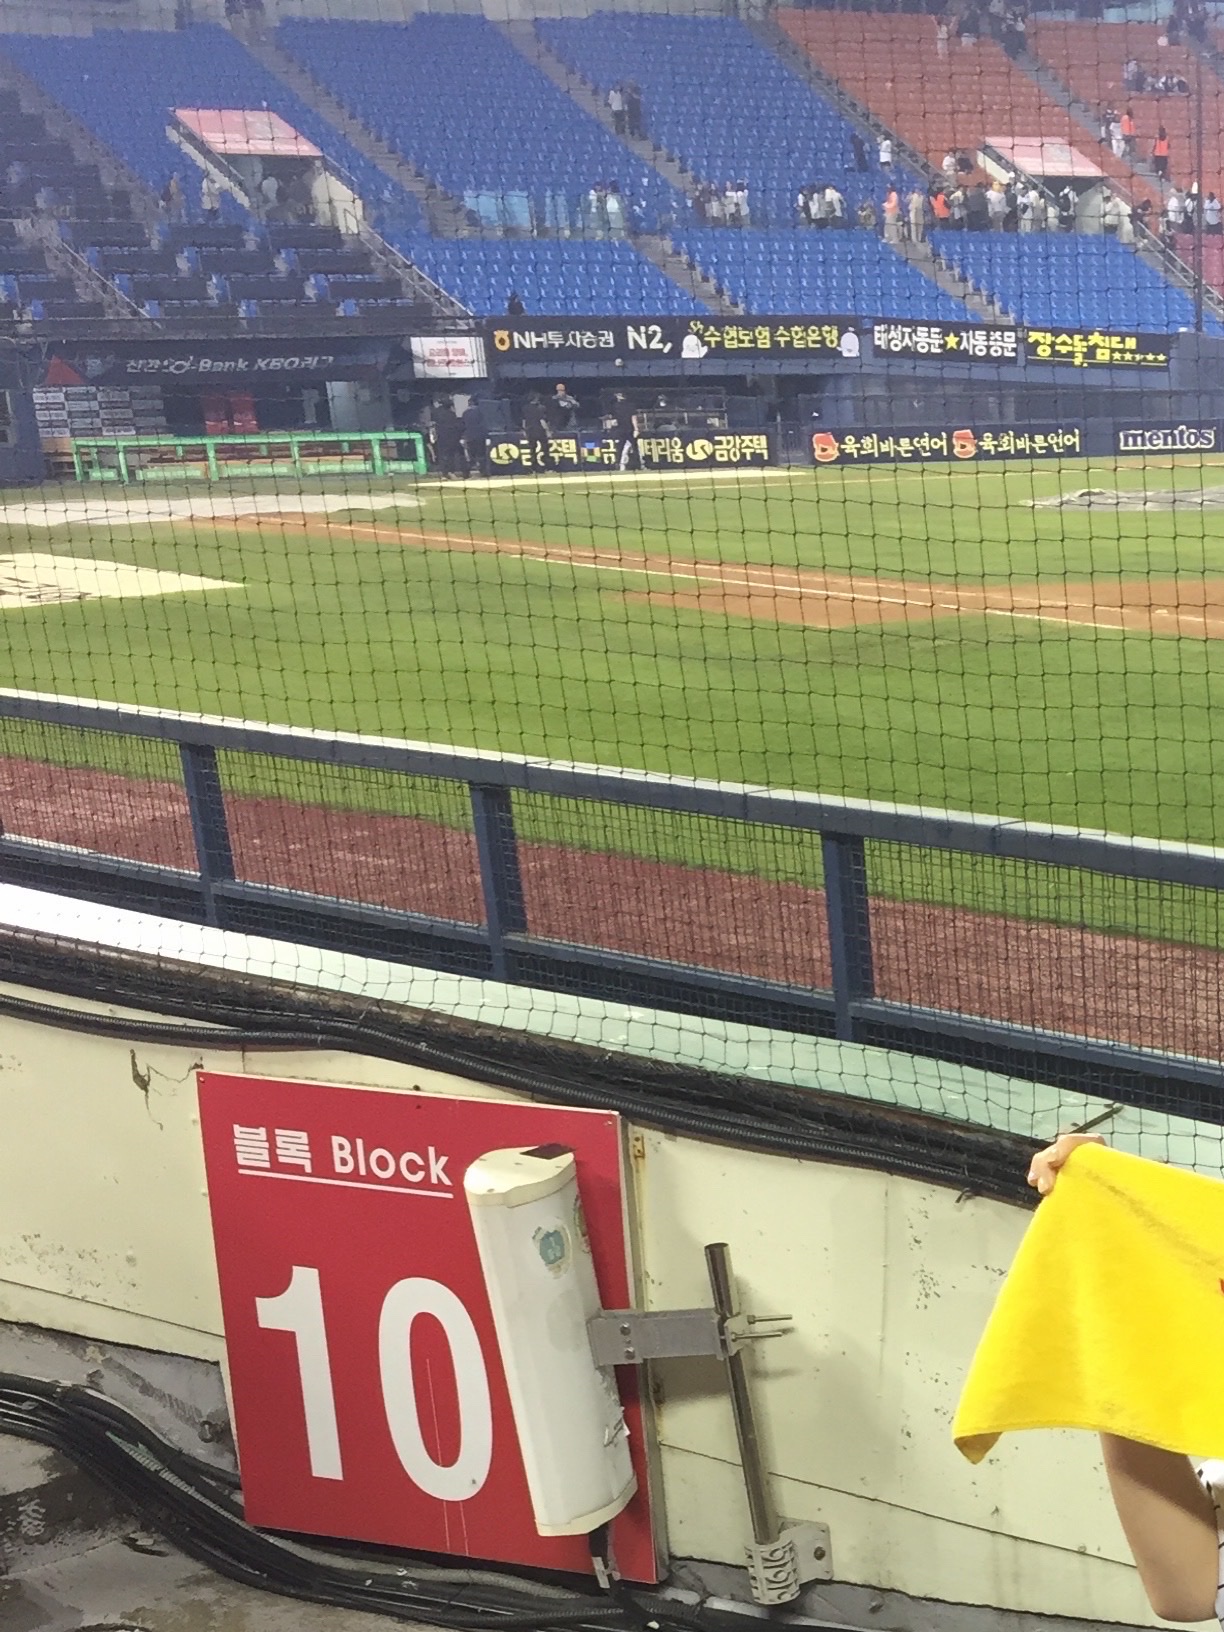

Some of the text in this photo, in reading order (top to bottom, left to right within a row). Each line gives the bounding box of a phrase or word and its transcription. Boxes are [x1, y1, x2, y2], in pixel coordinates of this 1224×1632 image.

[704, 325, 839, 349] 수협보험 수협은행
[1028, 331, 1137, 367] 장수돌침대
[714, 434, 769, 463] 금강주택
[840, 432, 948, 458] 육회바른연어
[1119, 425, 1215, 450] mentos
[232, 1123, 453, 1186] 블록 Block
[254, 1265, 494, 1502] 10
